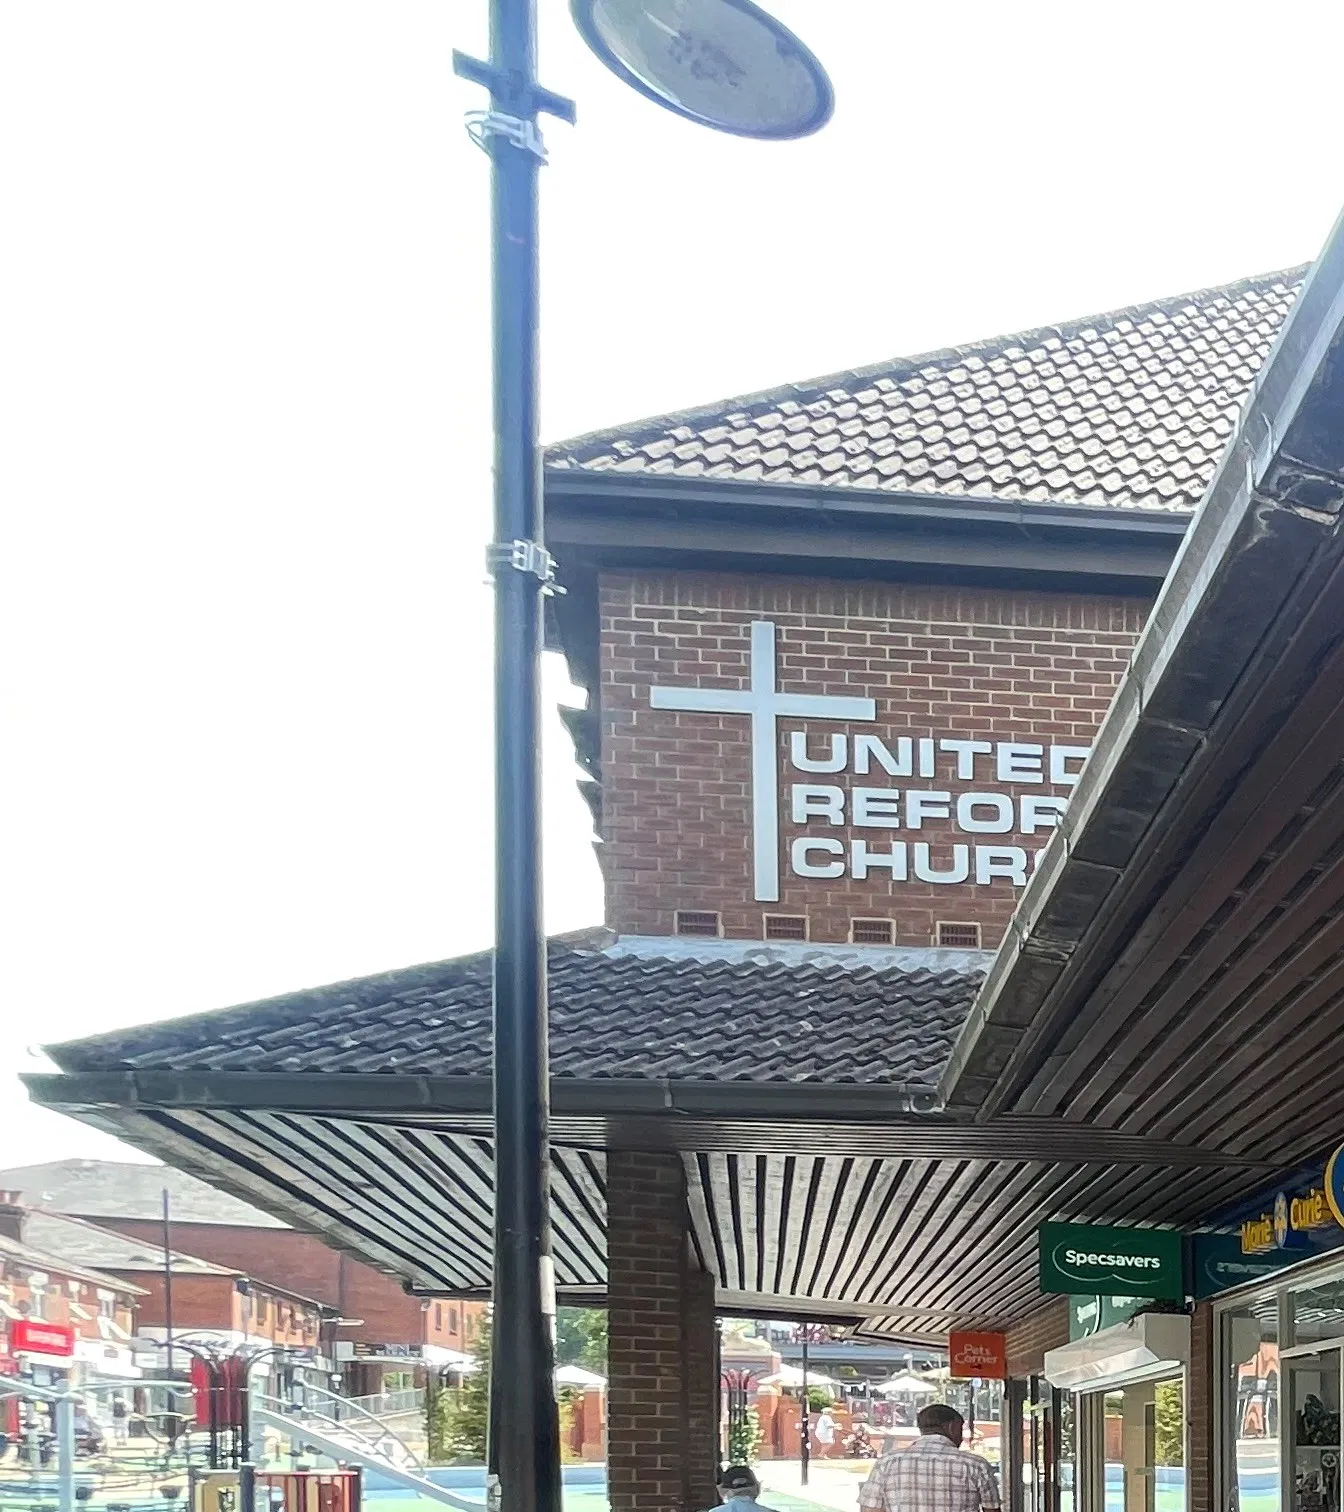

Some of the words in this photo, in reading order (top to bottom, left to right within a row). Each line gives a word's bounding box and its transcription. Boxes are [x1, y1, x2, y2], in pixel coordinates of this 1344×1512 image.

[790, 731, 1092, 785] UNITED
[791, 837, 1048, 887] CHUR
[1290, 1188, 1322, 1231] Curie
[1065, 1249, 1161, 1269] Specsavers
[954, 1353, 998, 1365] Corner
[963, 1343, 992, 1356] Pets
